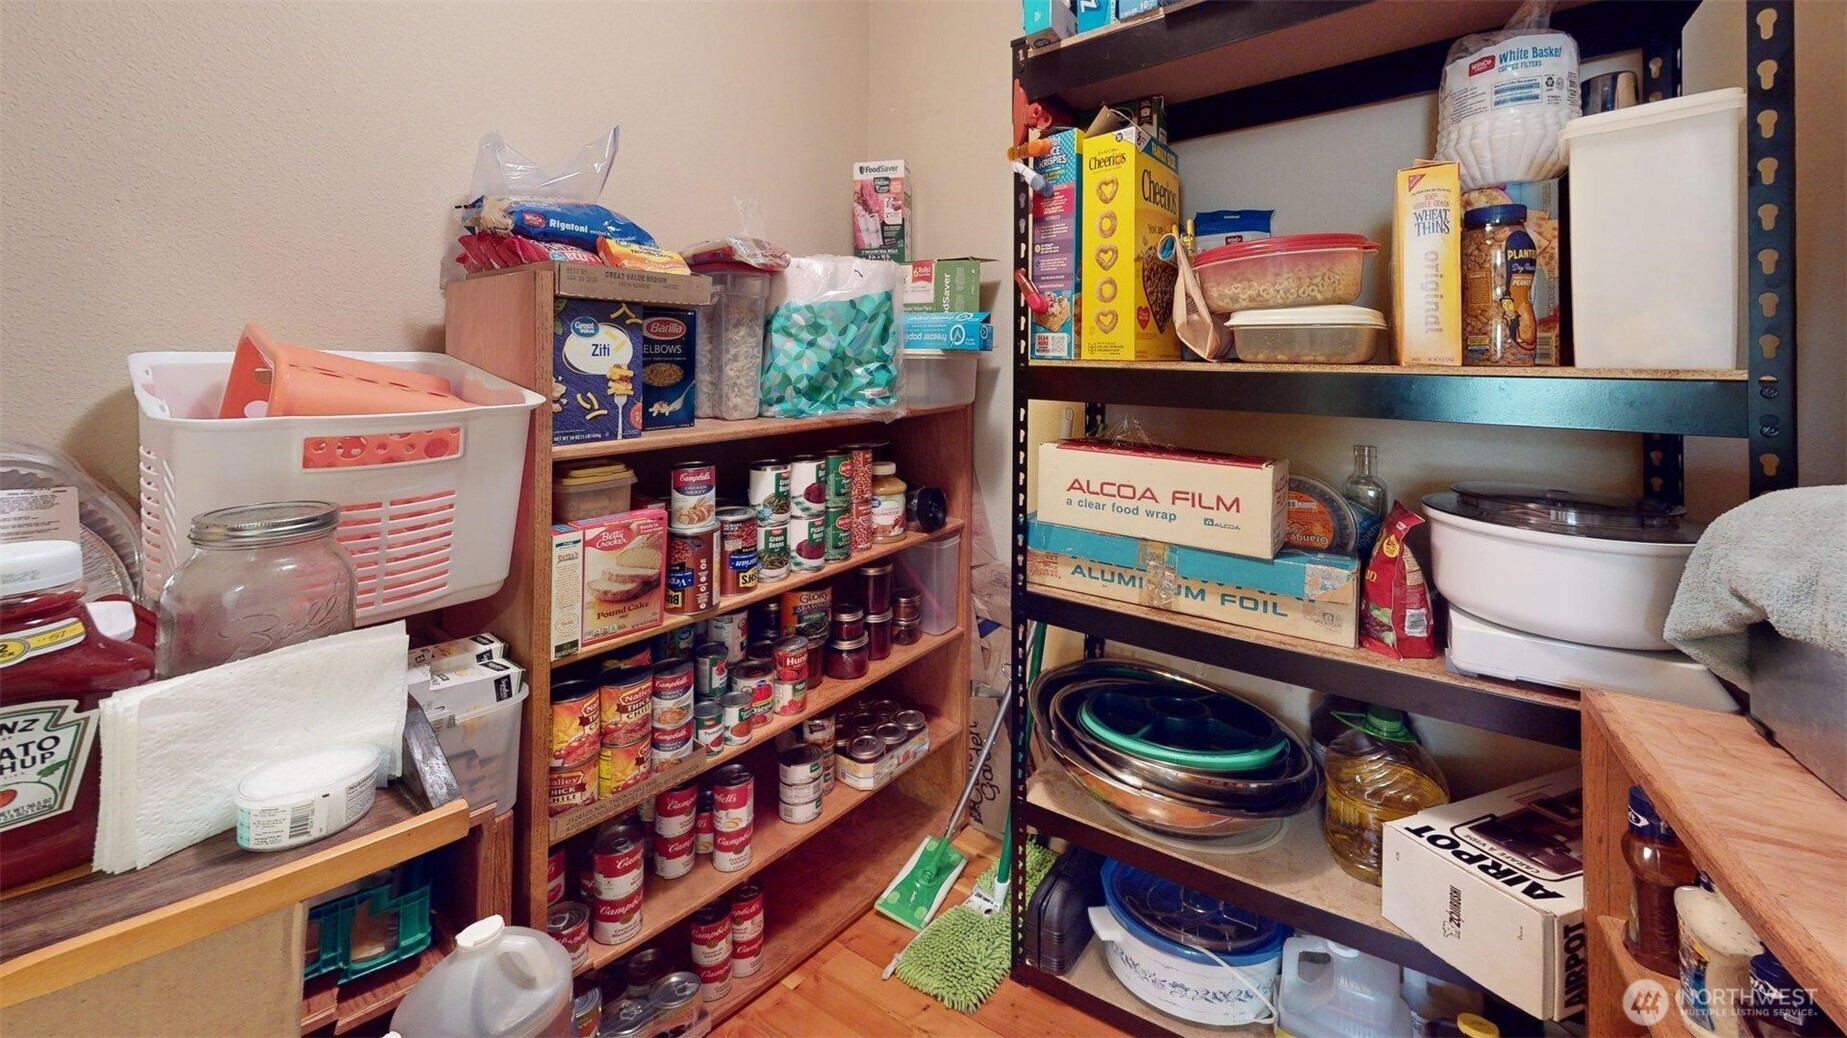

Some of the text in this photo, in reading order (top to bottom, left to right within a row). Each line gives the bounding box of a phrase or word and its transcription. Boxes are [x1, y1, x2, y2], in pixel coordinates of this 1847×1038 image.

[1498, 46, 1562, 64] White Basket
[1520, 60, 1542, 69] FILTERS
[1088, 152, 1126, 171] Cheerios
[866, 166, 898, 174] FoodSaver
[1142, 168, 1176, 214] Cheerios
[1413, 209, 1450, 222] WHEAT
[549, 218, 588, 234] Rigatoni
[1414, 220, 1450, 237] THINS
[604, 271, 626, 280] GREAT
[626, 272, 646, 281] VALUE
[1420, 251, 1443, 334] original
[574, 322, 595, 330] Great
[650, 322, 682, 334] Barilla
[592, 344, 610, 356] Ziti
[644, 344, 682, 354] ELBOWS
[1066, 478, 1241, 514] ALCOA FILM
[1066, 498, 1177, 524] a clear food wrap
[1214, 522, 1241, 531] ALCOA
[600, 530, 624, 541] Betty
[1290, 534, 1328, 545] Orange
[596, 537, 629, 549] Crocker
[800, 592, 828, 604] GLORY
[628, 602, 650, 612] Cake
[1220, 594, 1288, 618] FOIL
[597, 606, 626, 620] Pound
[0, 735, 60, 760] ATO
[550, 777, 578, 786] alley
[550, 786, 576, 795] HICK
[1404, 825, 1566, 900] AIRPOT
[1563, 922, 1586, 1008] AIRPOT
